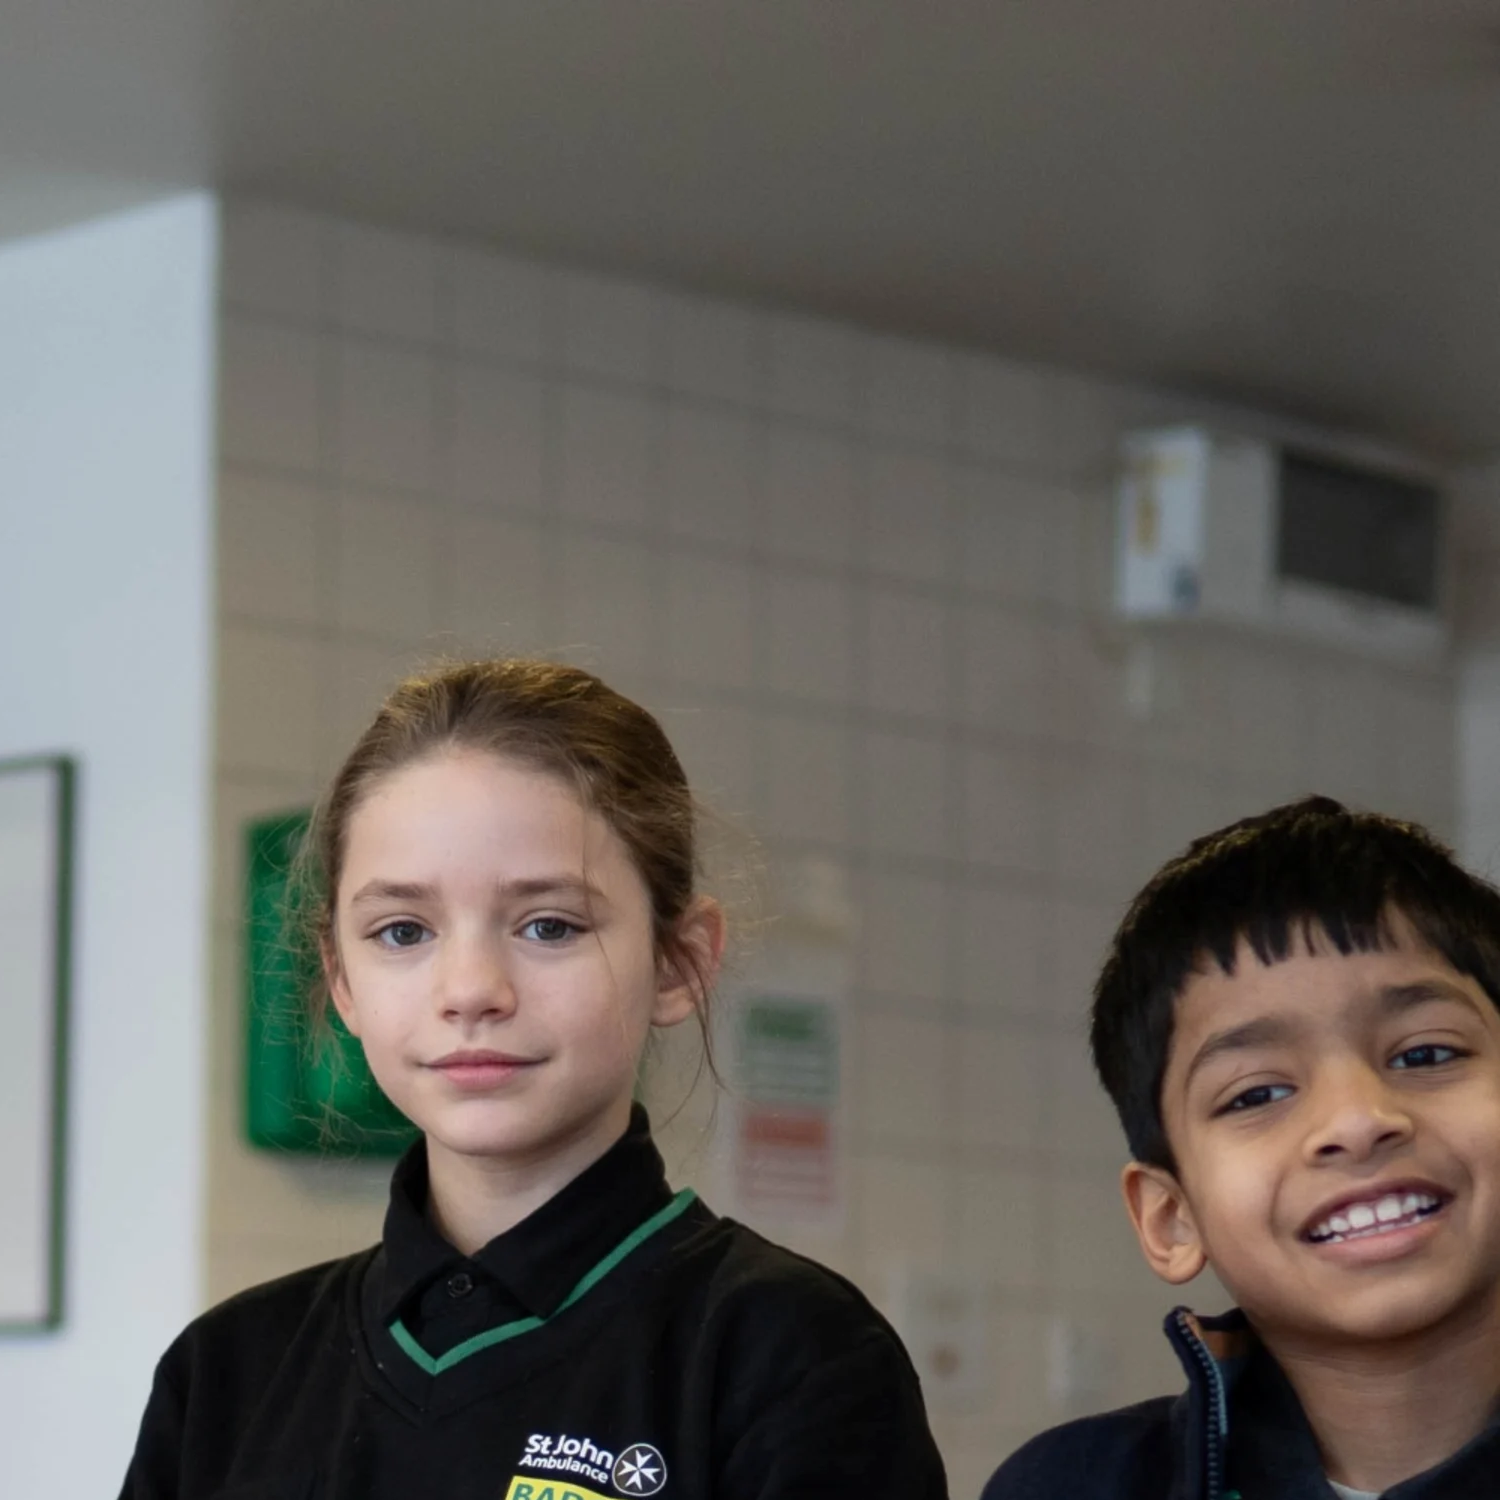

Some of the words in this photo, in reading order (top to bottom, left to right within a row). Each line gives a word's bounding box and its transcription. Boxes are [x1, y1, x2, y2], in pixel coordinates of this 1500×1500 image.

[524, 1433, 553, 1455] St
[552, 1434, 614, 1469] John
[518, 1453, 609, 1484] Ambulance
